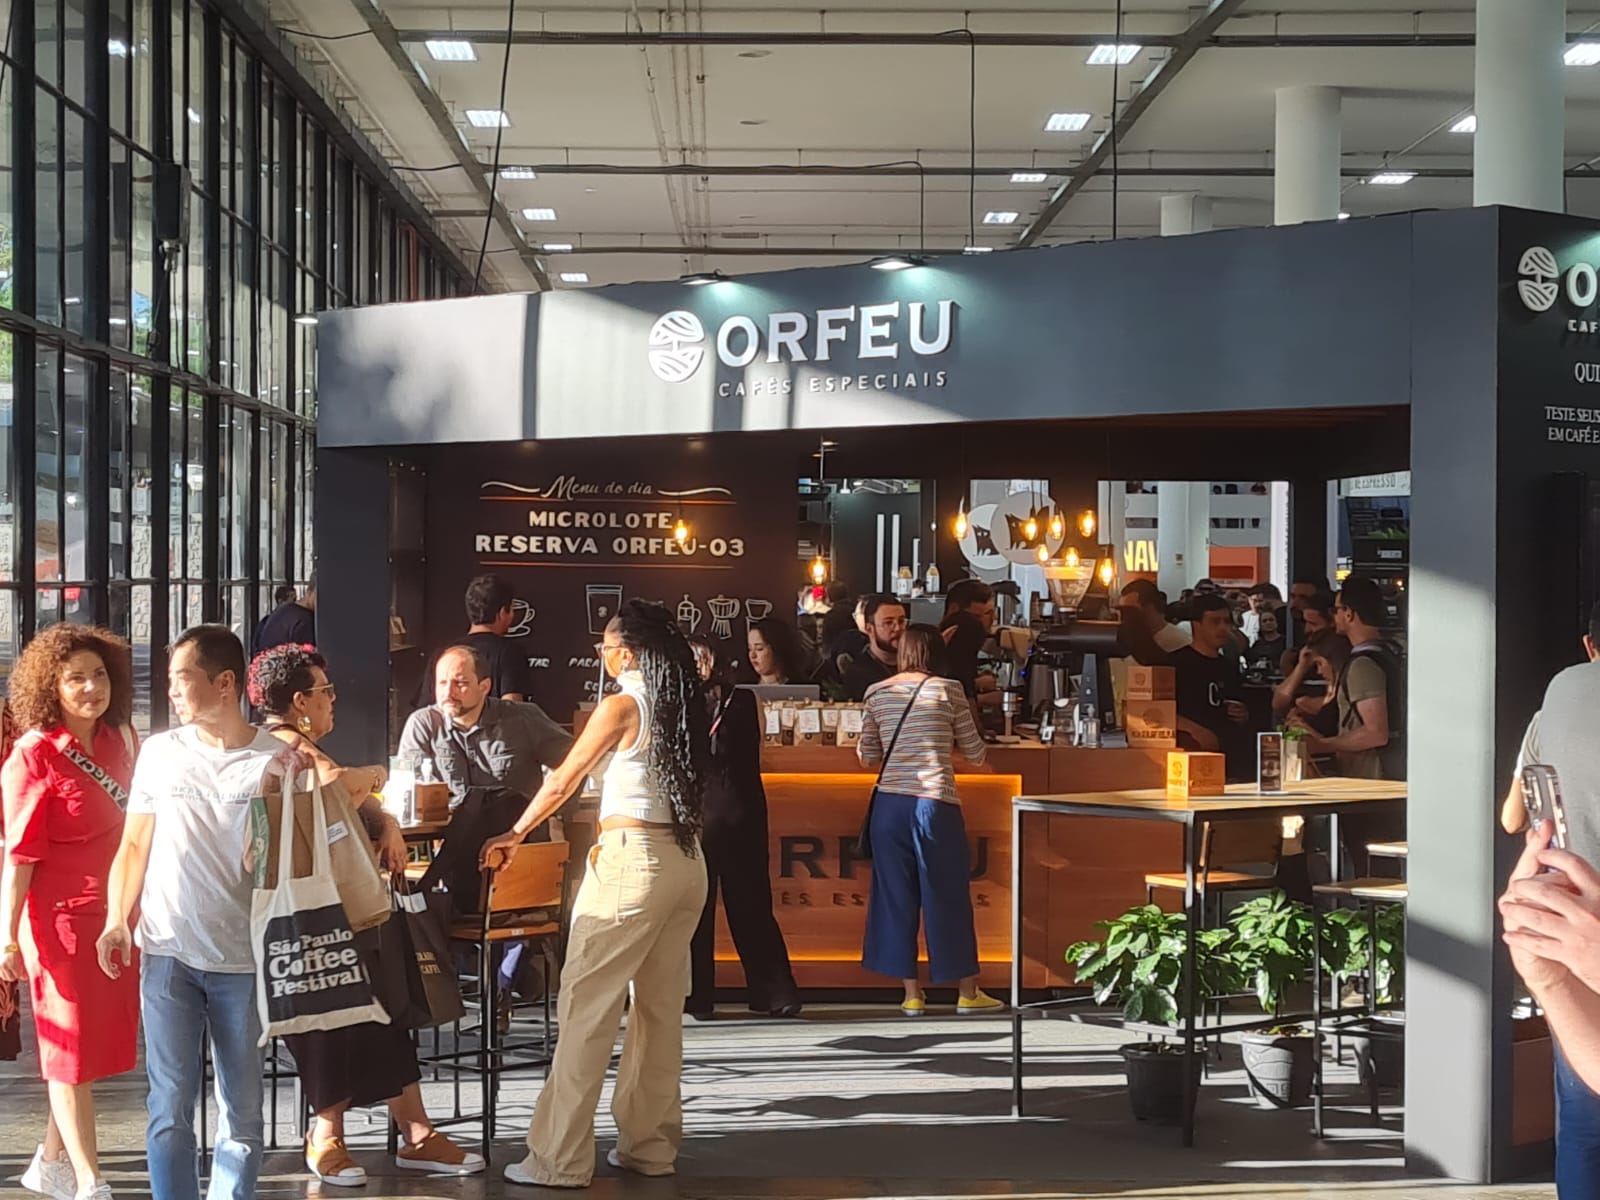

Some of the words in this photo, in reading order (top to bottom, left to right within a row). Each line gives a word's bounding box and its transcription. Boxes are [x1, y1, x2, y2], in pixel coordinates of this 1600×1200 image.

[716, 299, 953, 368] ORFEU
[719, 377, 793, 398] CAFÉS
[809, 370, 948, 394] ESPECIAIS
[1544, 406, 1576, 421] TESTE
[1548, 427, 1564, 441] EM
[1565, 425, 1591, 443] CAFÉ
[540, 475, 599, 501] Menu
[628, 482, 652, 495] dia
[528, 510, 673, 529] MICROLOTE
[475, 534, 598, 554] RESERVA
[612, 536, 745, 557] ORFEU-03
[299, 928, 354, 949] Paulo
[269, 947, 358, 978] Coffee
[271, 965, 363, 998] Festival
